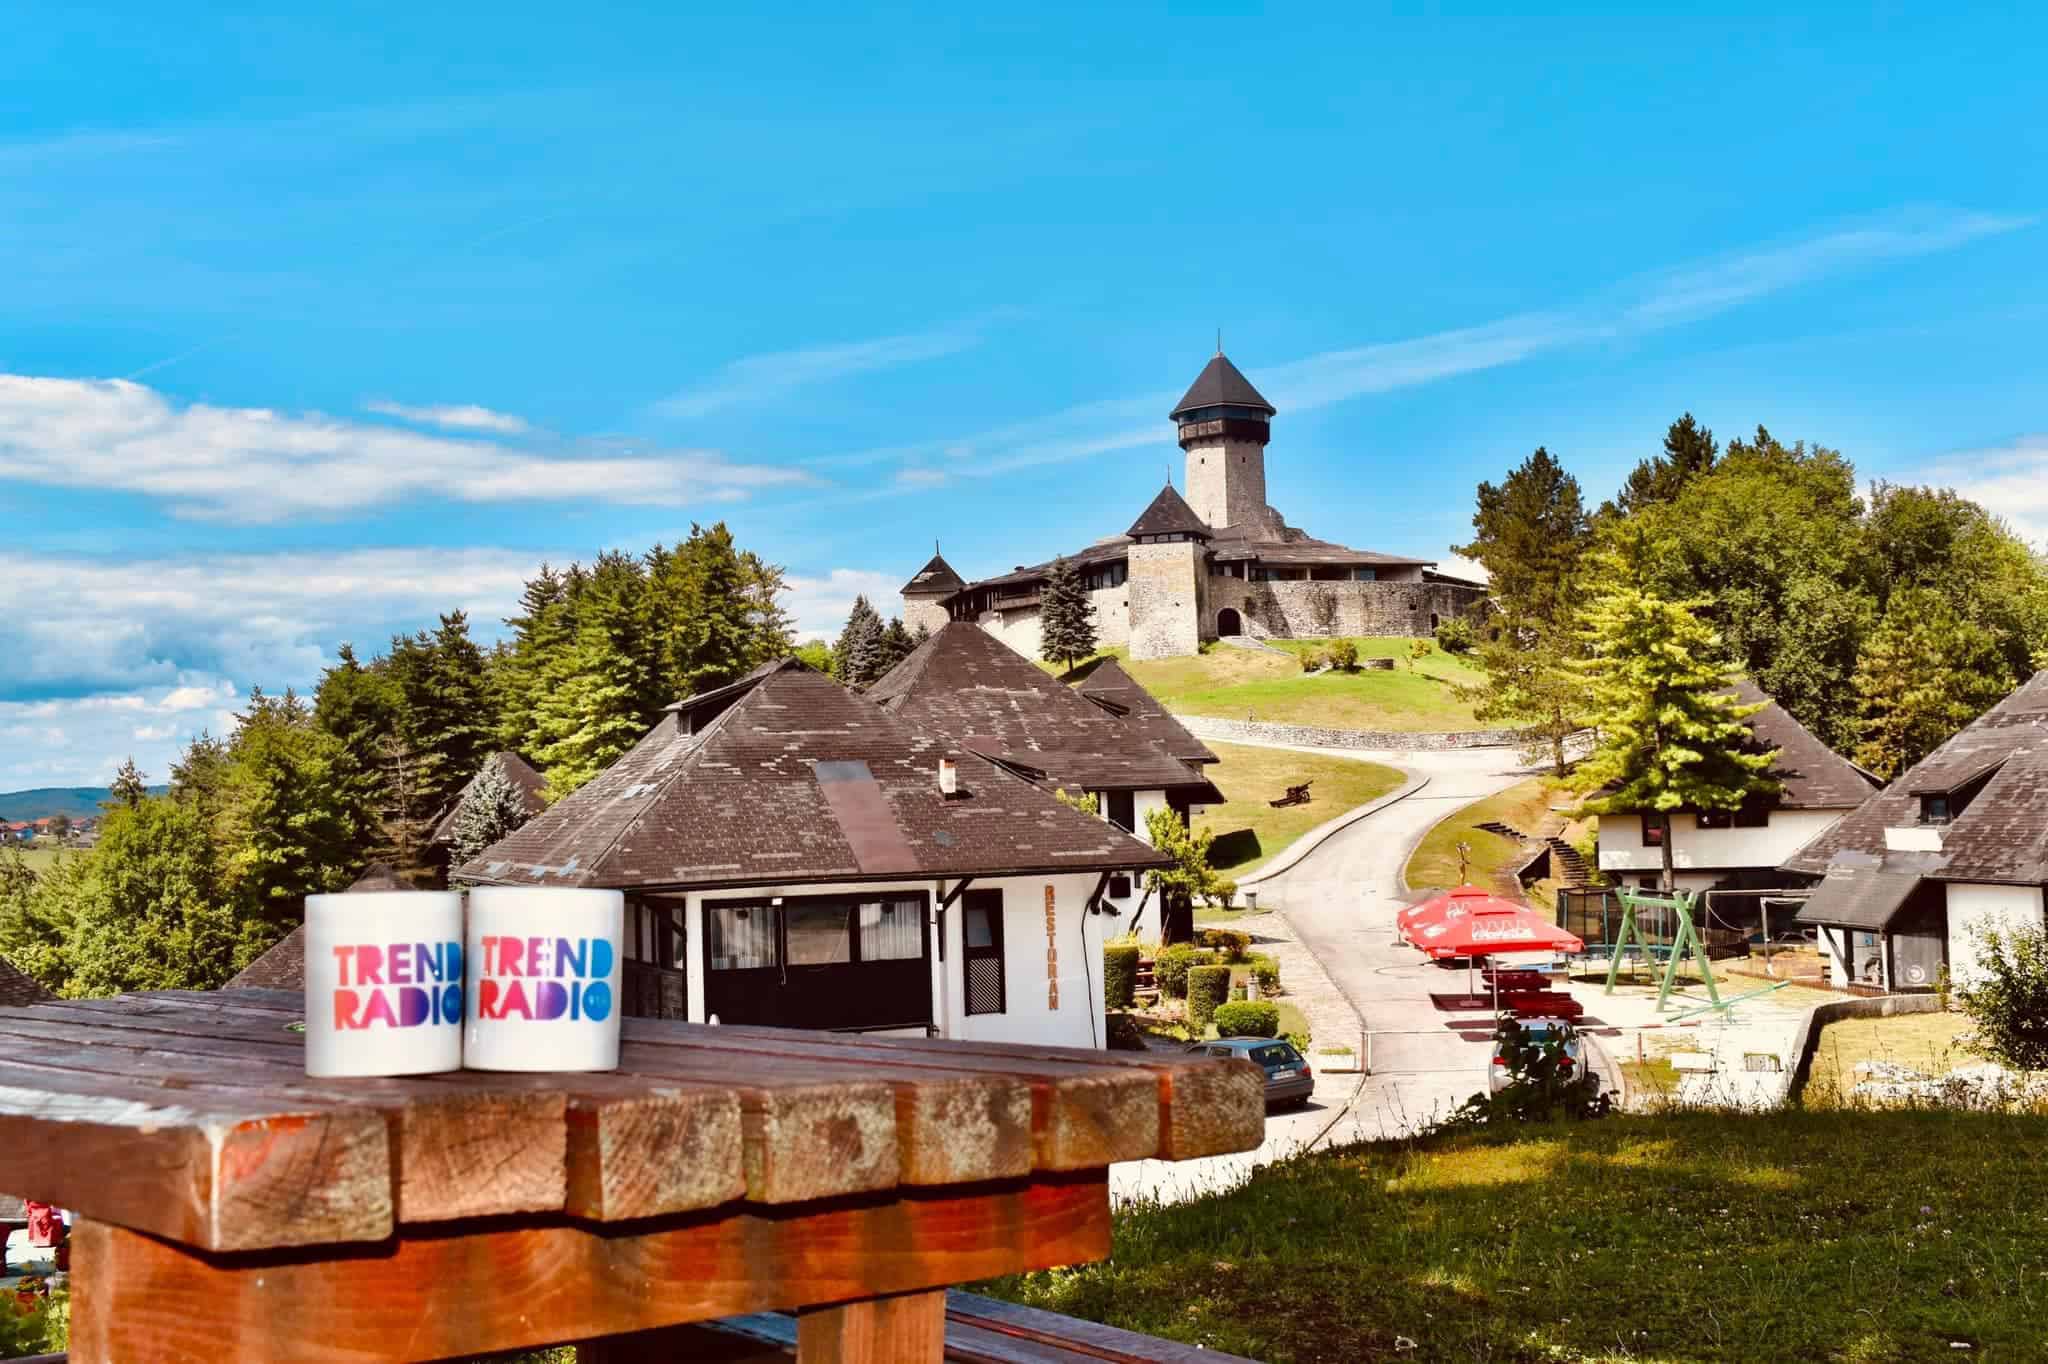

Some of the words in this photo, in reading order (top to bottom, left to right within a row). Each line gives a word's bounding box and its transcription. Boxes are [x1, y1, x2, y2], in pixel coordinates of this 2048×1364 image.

[333, 942, 462, 985] TREND
[481, 936, 613, 978] TREND
[333, 983, 462, 1031] RADIO
[479, 980, 611, 1021] RADIO
